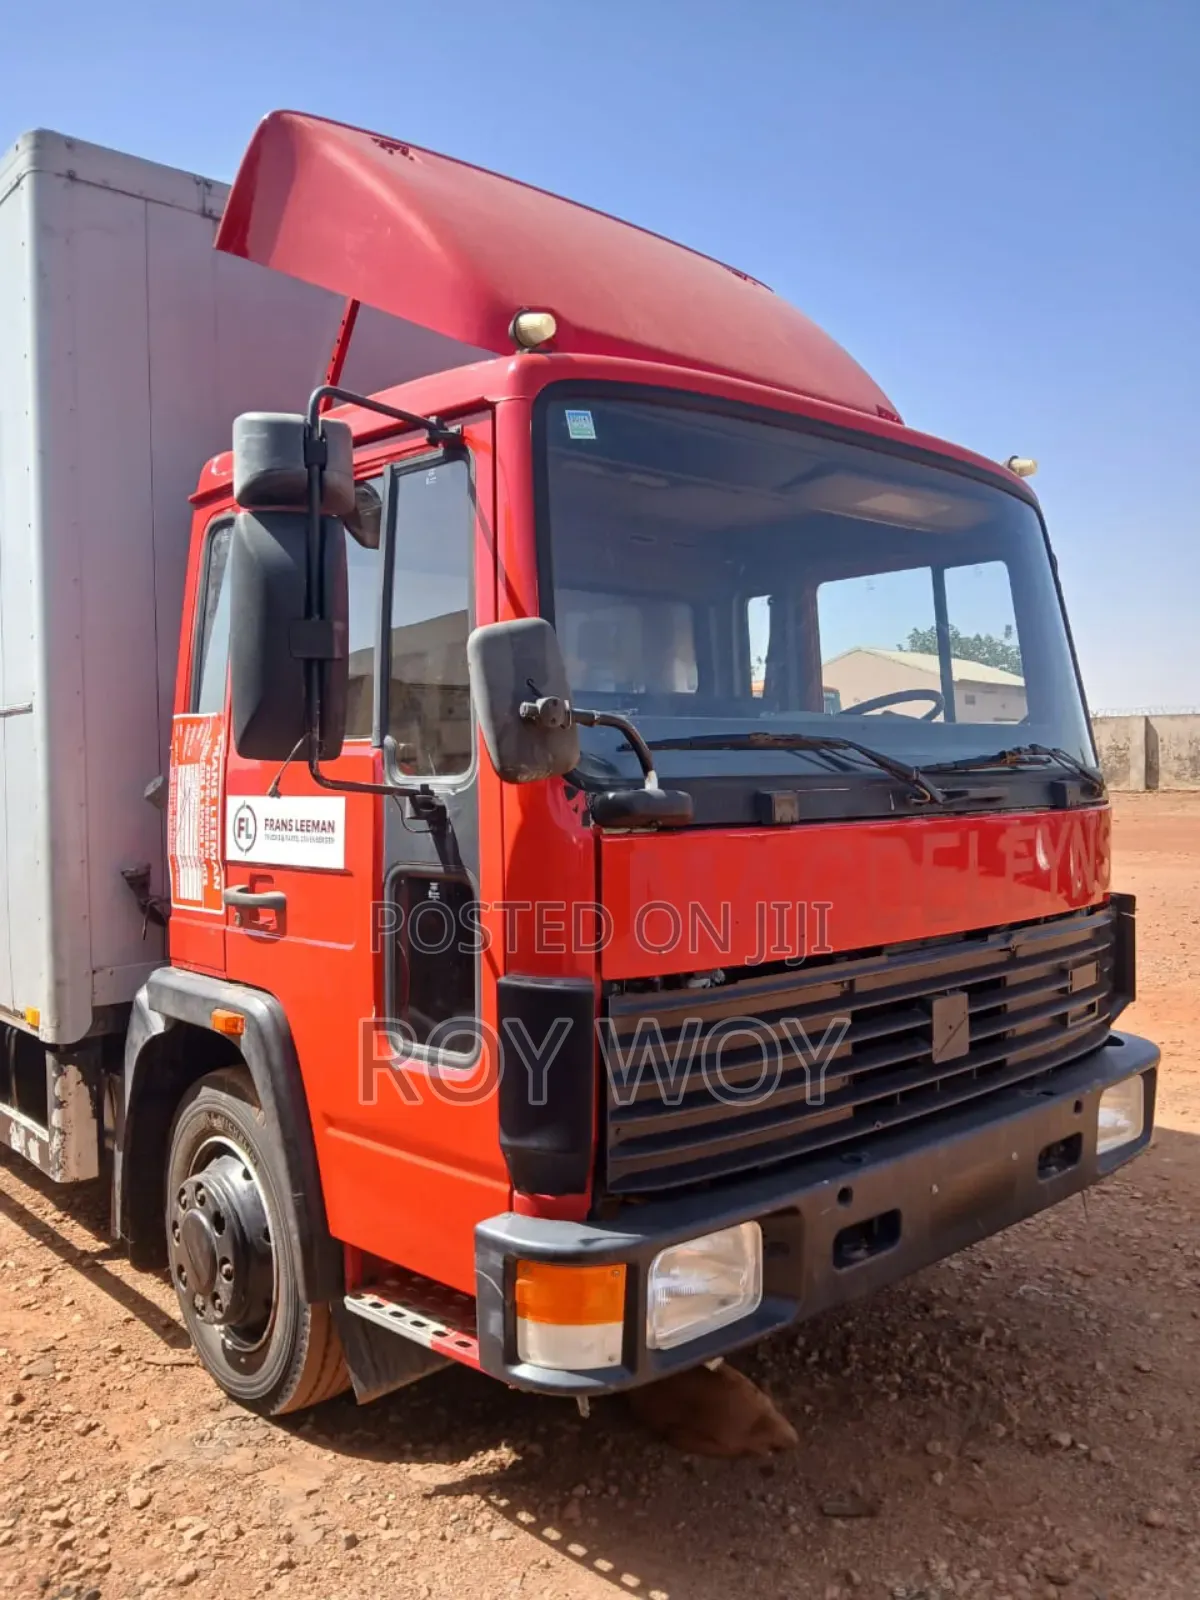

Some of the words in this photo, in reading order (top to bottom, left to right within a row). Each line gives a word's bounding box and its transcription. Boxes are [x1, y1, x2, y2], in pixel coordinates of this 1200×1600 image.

[238, 817, 252, 839] FL
[264, 818, 293, 832] FRANS
[295, 819, 335, 833] LEEMAN
[209, 805, 222, 890] LEEMAN
